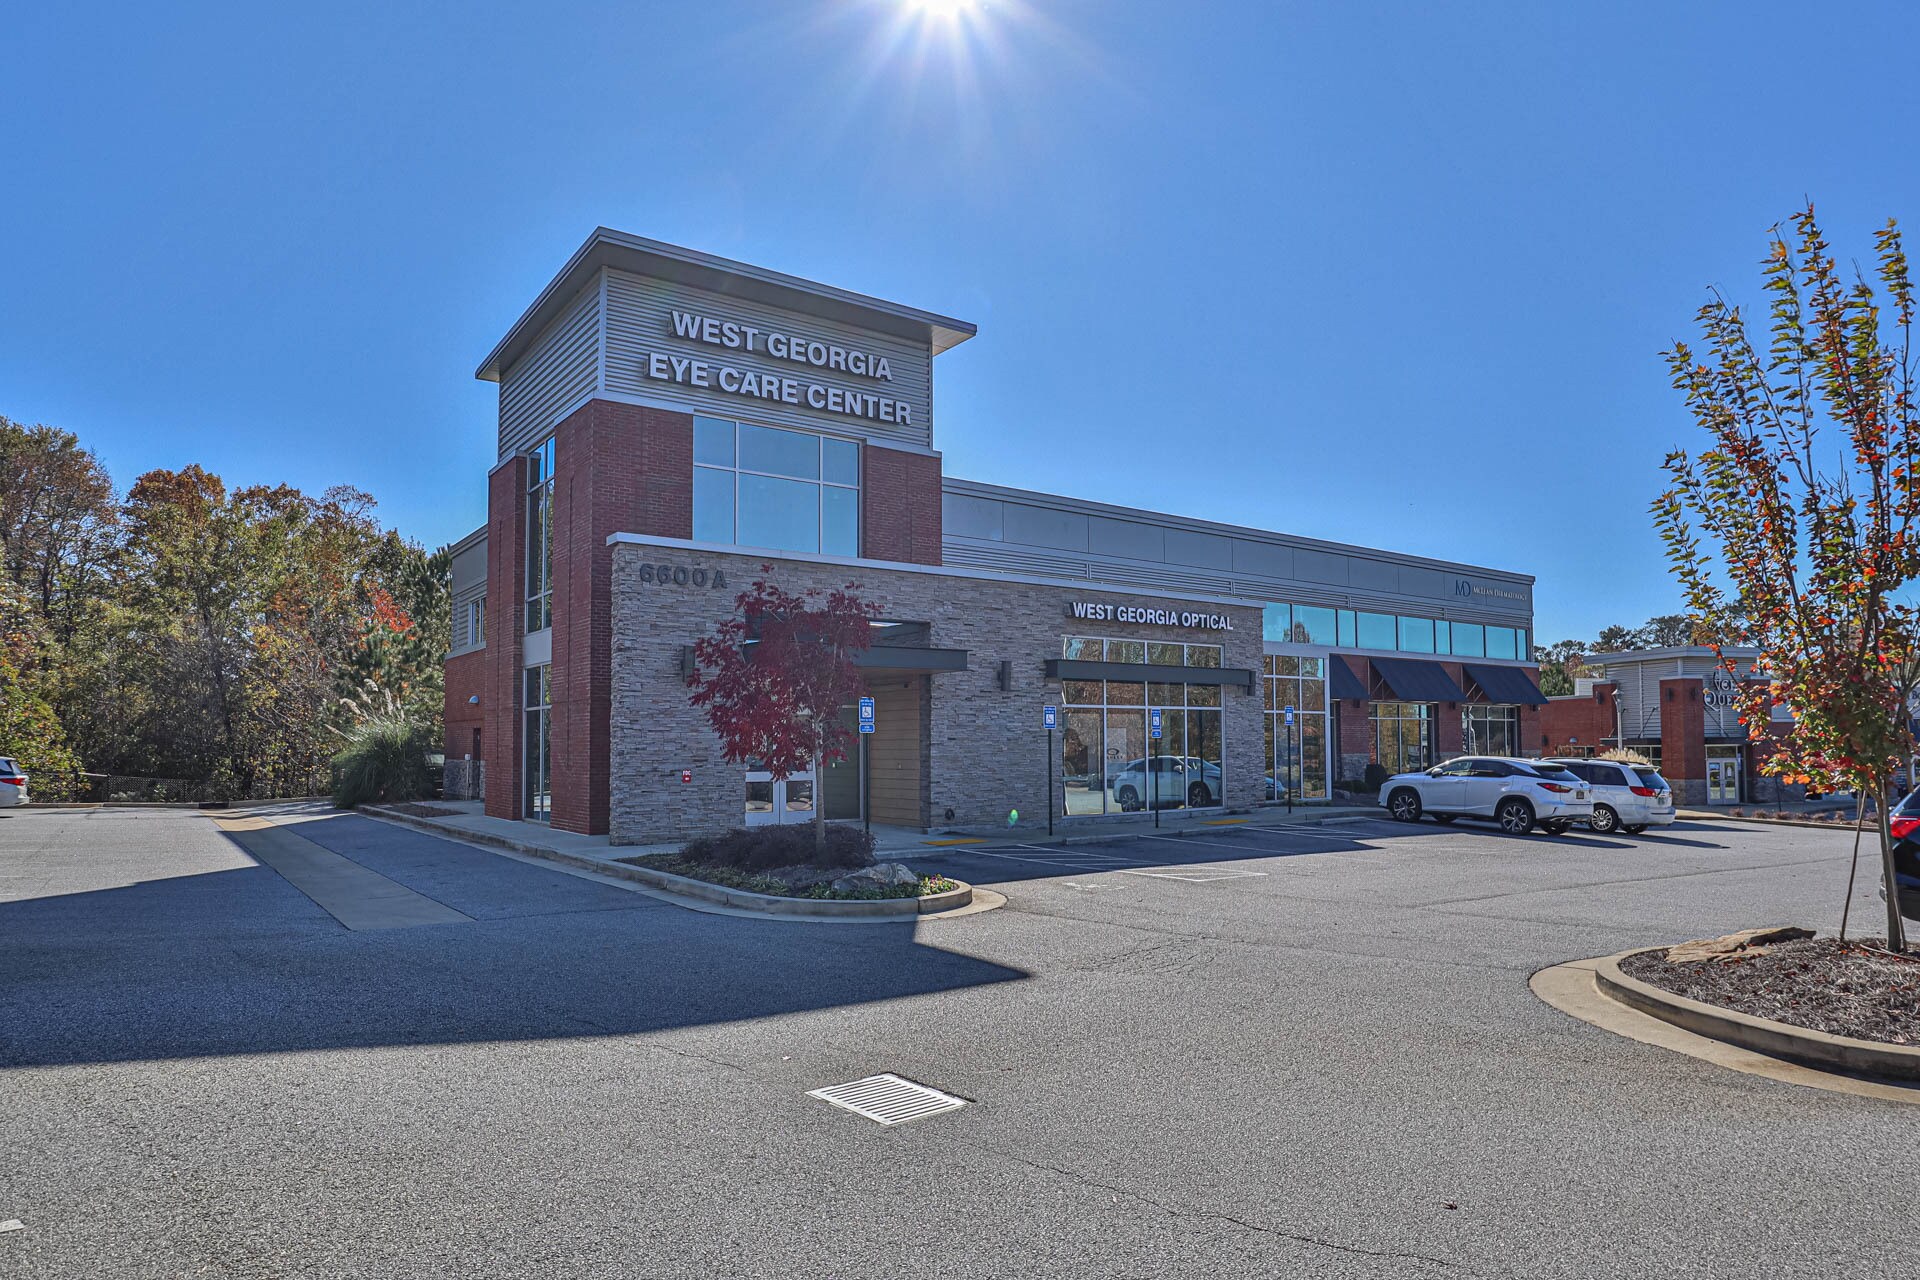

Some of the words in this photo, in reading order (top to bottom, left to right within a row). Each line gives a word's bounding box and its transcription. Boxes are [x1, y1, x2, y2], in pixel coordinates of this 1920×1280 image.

[670, 310, 758, 351] WEST
[767, 332, 893, 381] GEORGIA
[649, 351, 709, 388] EYE
[718, 366, 799, 404] CARE
[807, 384, 912, 425] CENTER
[1072, 601, 1114, 620] WEST
[1117, 606, 1179, 627] GEORGIA
[1181, 611, 1234, 631] OPTICAL
